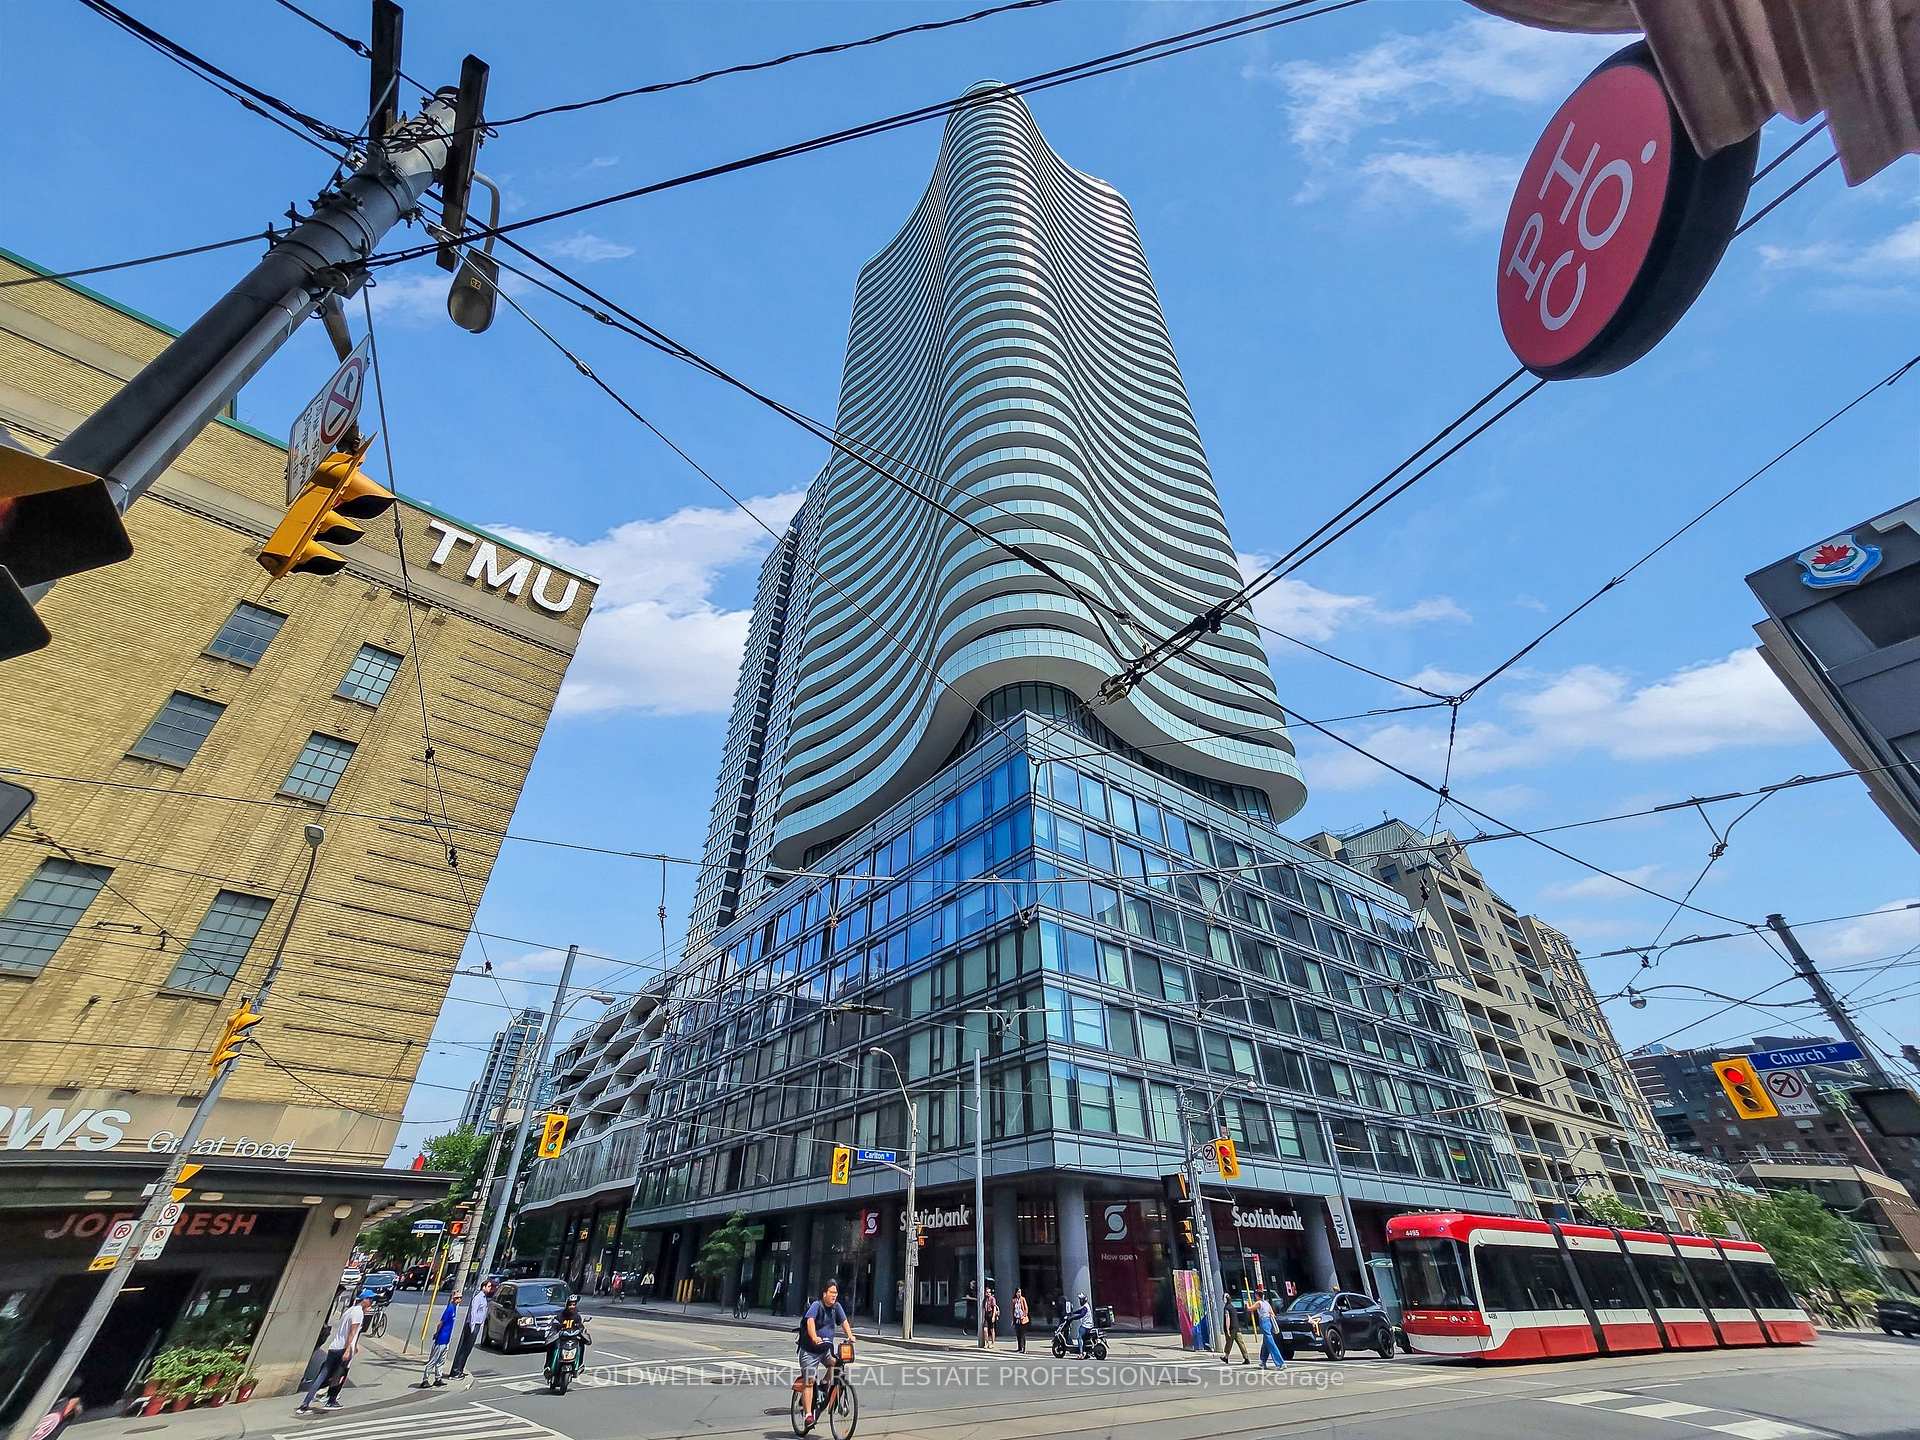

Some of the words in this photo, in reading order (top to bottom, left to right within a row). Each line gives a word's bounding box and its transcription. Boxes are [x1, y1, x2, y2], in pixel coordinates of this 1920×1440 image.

[1506, 120, 1600, 302] PHO
[429, 519, 581, 612] TMU
[1769, 1048, 1826, 1065] Church
[147, 1130, 227, 1155] Grat
[233, 1136, 297, 1160] food
[864, 1151, 885, 1160] Carlton
[1231, 1205, 1305, 1231] Scotiabank
[1333, 1214, 1347, 1243] TMU
[1101, 1252, 1118, 1261] Now
